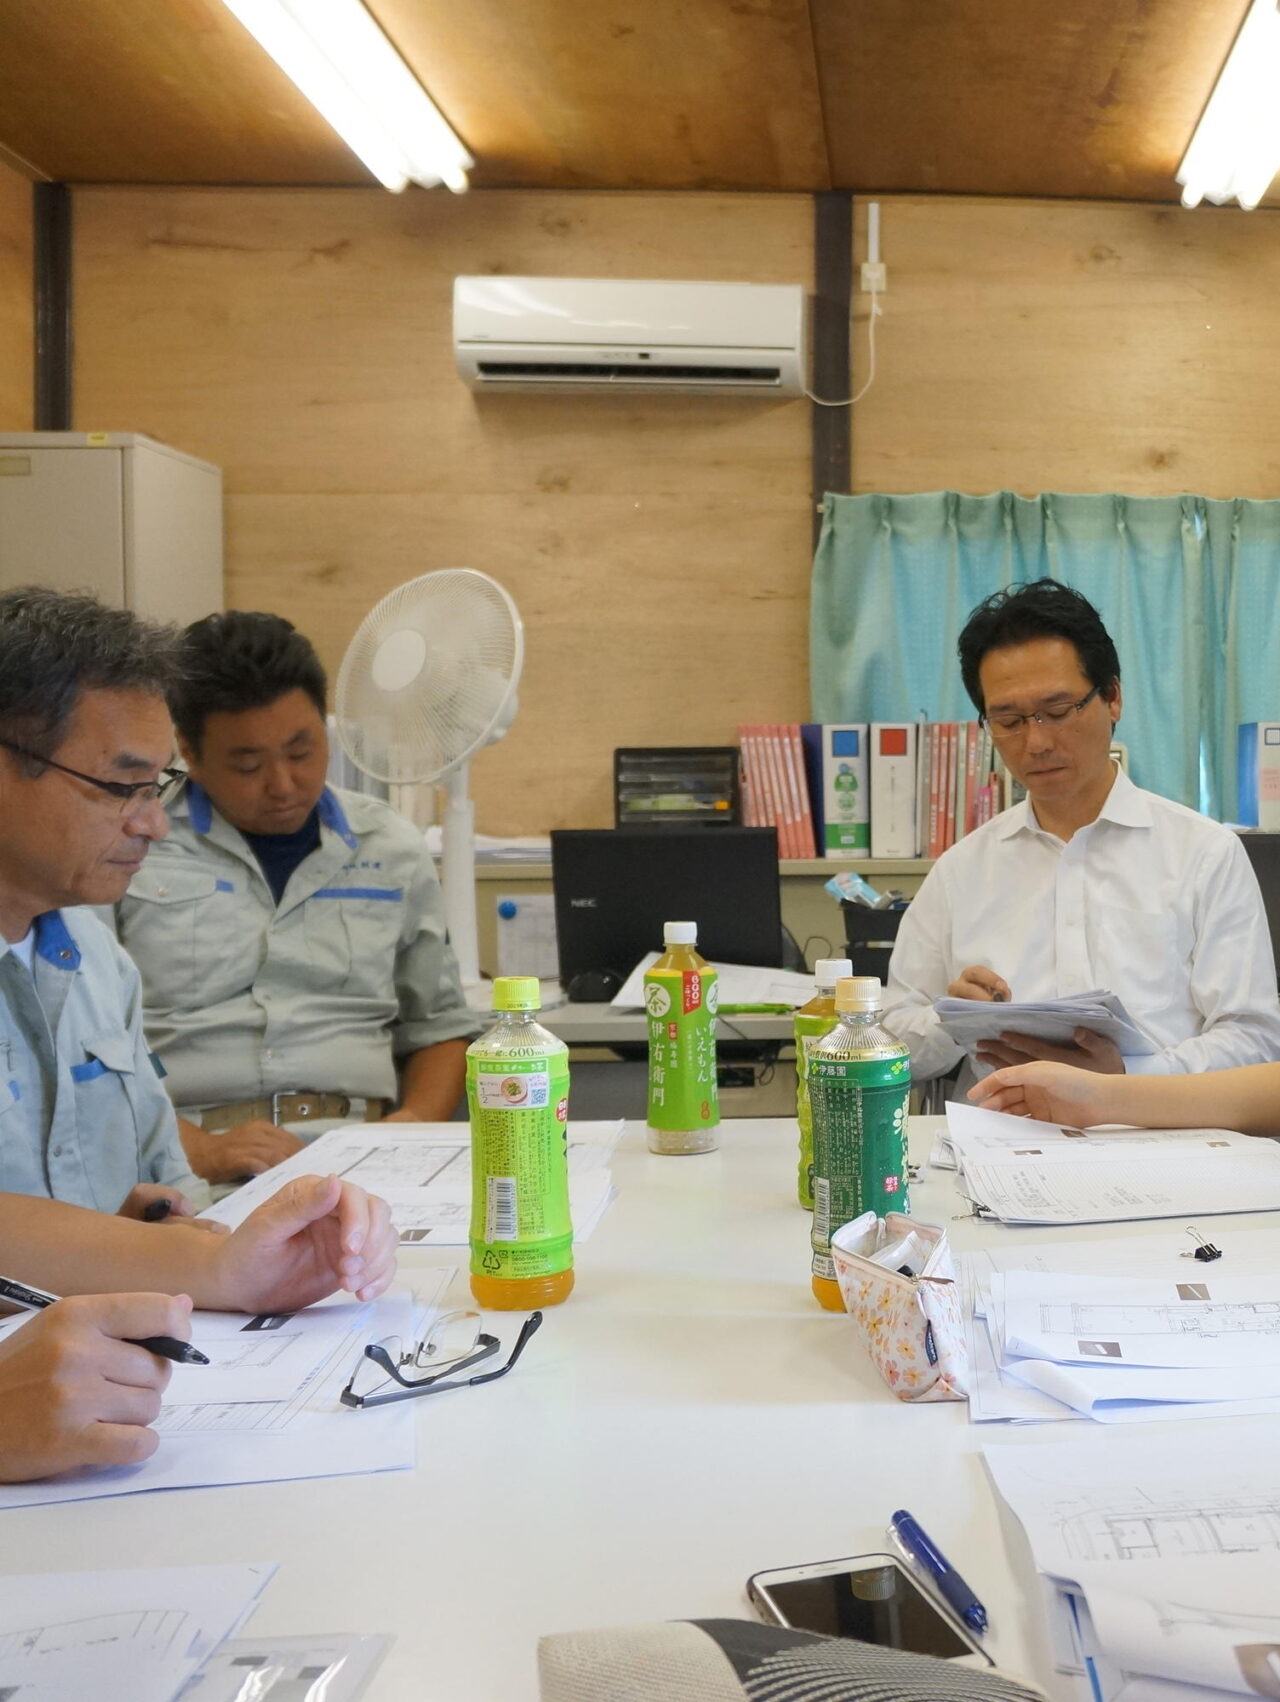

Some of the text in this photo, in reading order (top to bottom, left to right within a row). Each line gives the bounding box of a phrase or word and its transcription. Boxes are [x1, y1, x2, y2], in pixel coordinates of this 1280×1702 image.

[570, 898, 598, 908] NEC
[652, 1020, 666, 1107] 伊右衛門
[696, 1026, 709, 1083] いえもん
